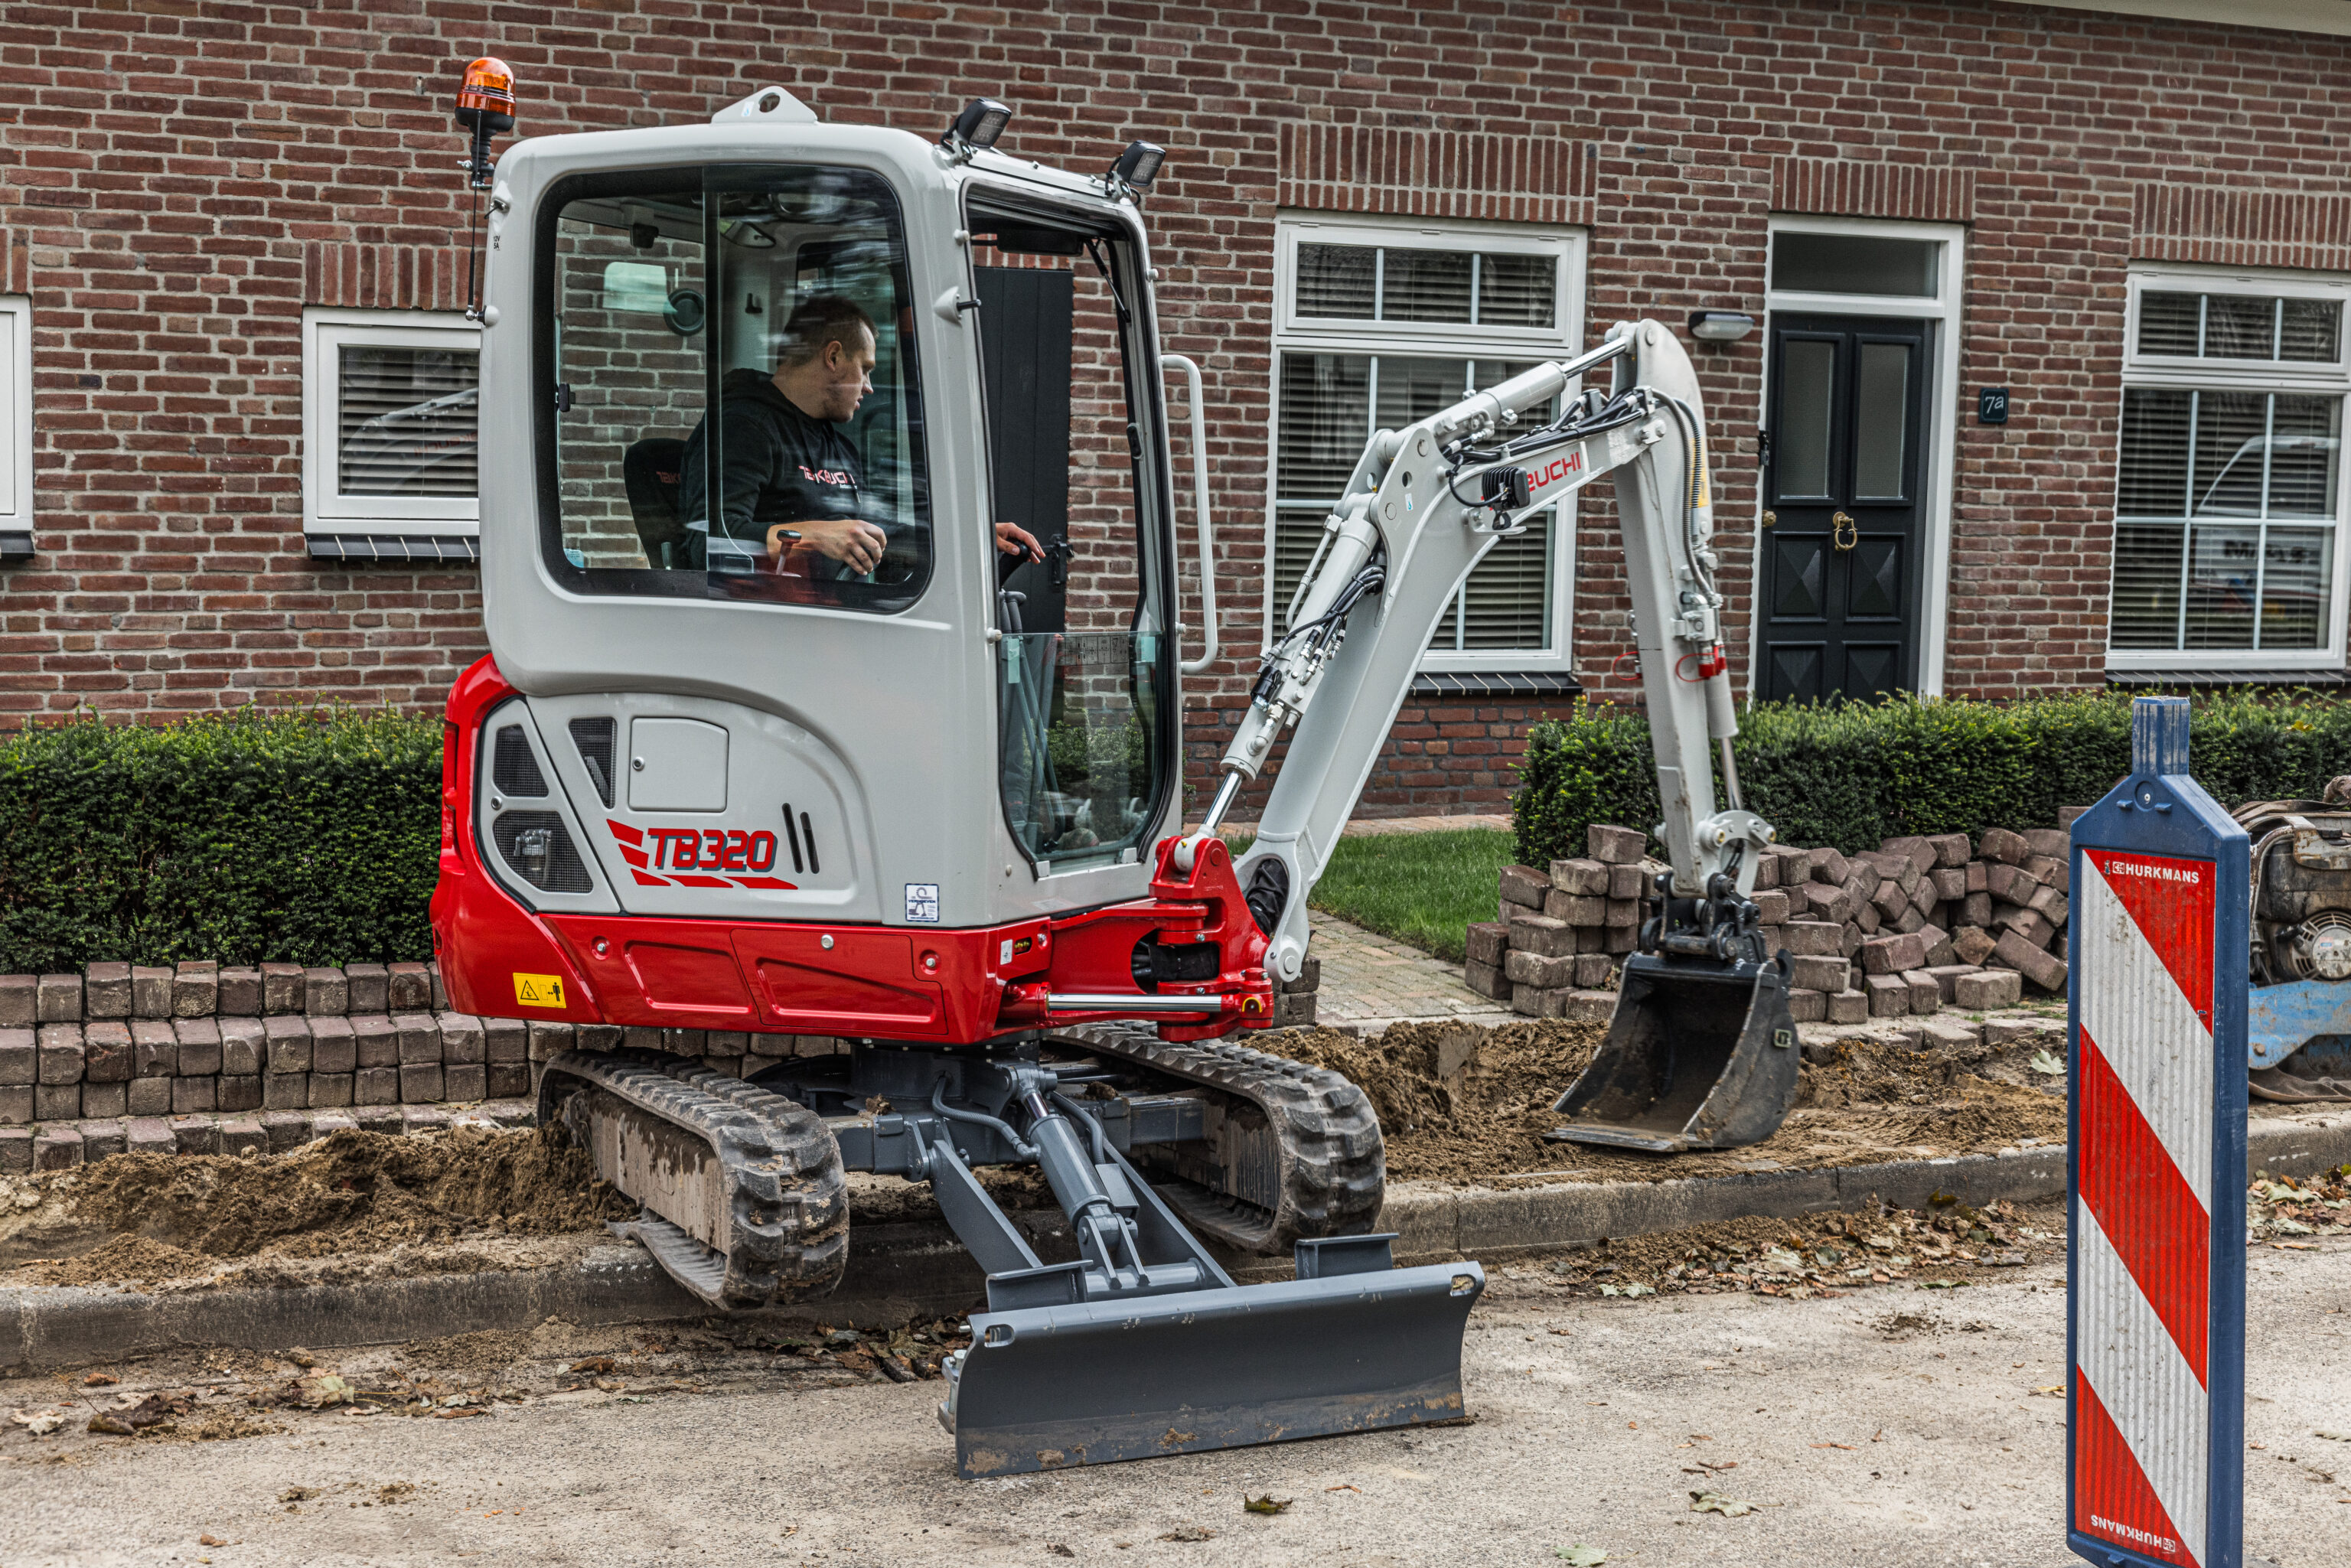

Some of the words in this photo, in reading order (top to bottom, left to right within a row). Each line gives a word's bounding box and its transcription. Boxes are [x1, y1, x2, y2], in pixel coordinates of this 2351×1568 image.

[1984, 396, 2004, 414] 7a
[647, 827, 778, 873] TB320
[2125, 863, 2199, 884] HURKMANS
[2090, 1514, 2162, 1548] HURKMANS
